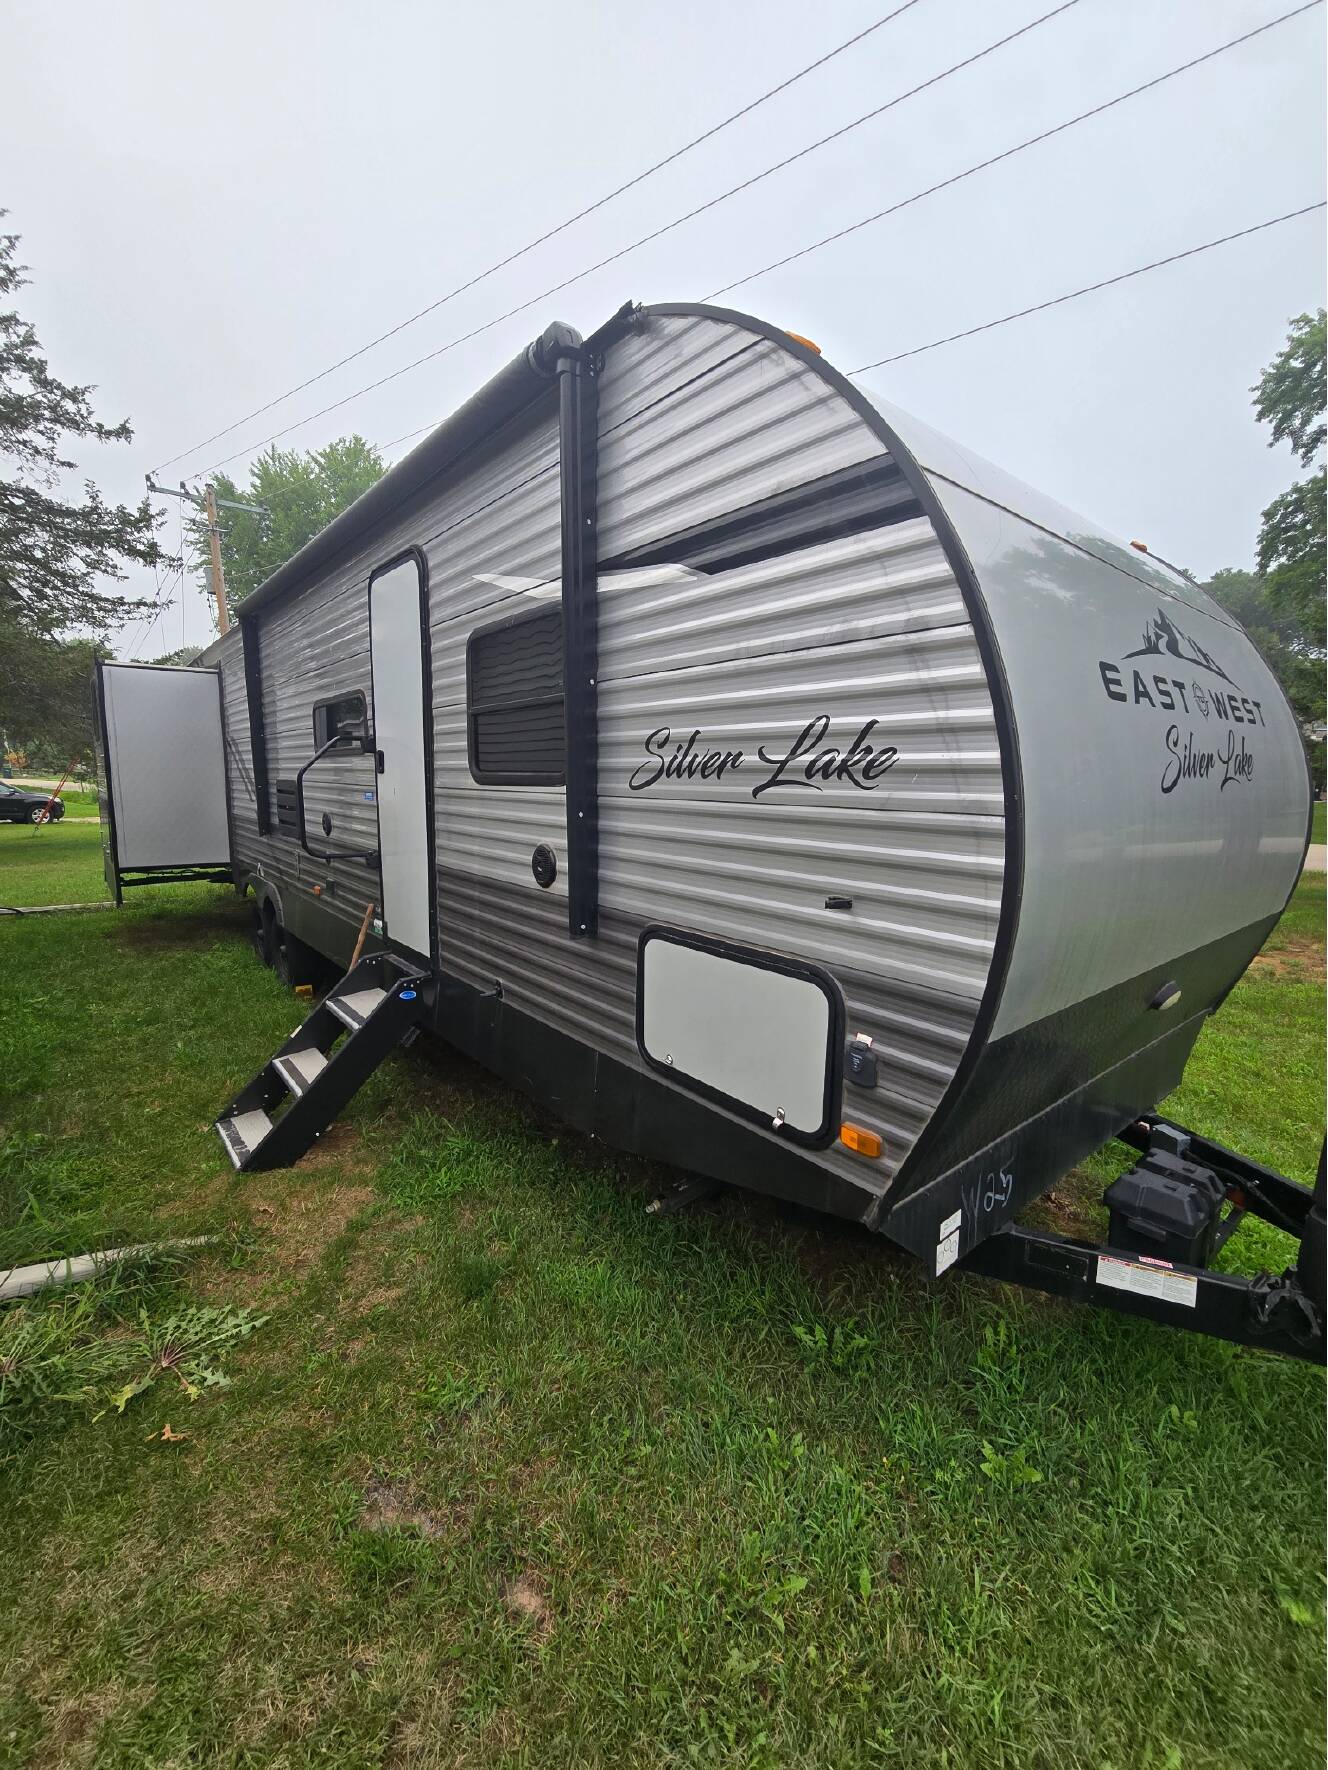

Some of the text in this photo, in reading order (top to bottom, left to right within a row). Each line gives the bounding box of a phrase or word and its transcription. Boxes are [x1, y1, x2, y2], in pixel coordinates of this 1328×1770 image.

[1099, 661, 1266, 727] EAST WEST
[628, 714, 900, 800] Silver Lake
[1161, 724, 1253, 794] Silver Lake
